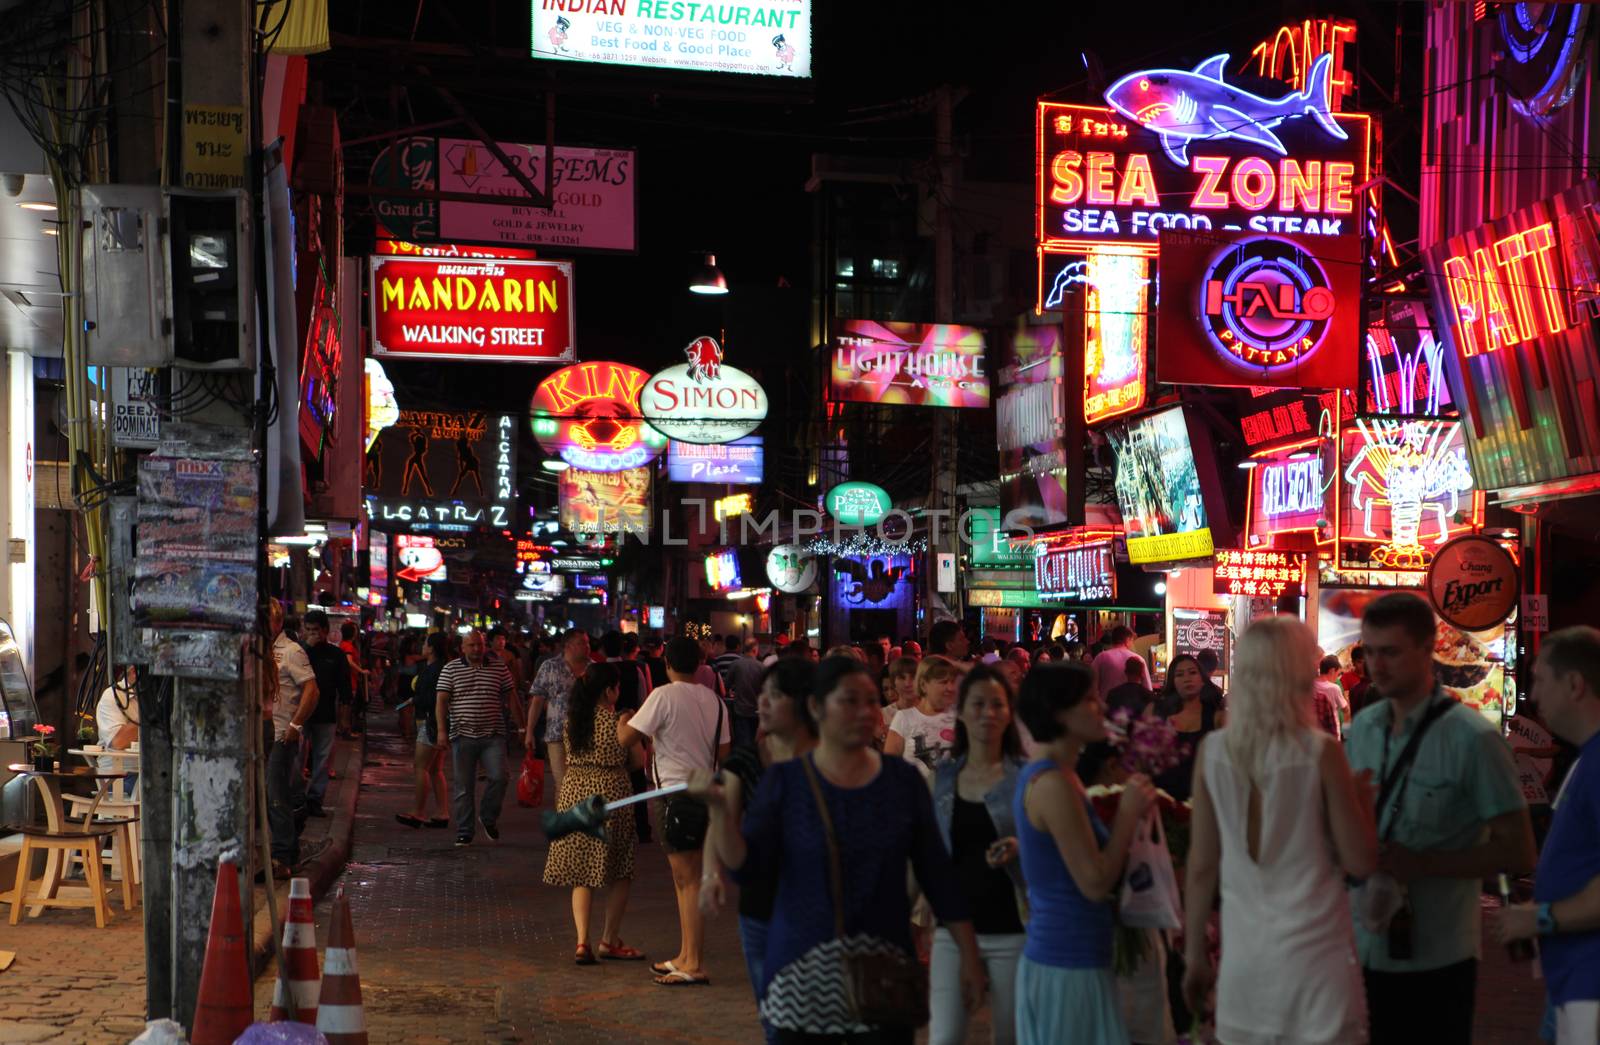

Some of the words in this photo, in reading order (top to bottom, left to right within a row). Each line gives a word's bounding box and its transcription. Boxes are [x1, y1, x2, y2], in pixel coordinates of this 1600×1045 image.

[542, 0, 626, 16] INDIAN
[637, 0, 802, 29] RESTAURANT
[596, 21, 624, 35] VEG
[629, 23, 637, 35] &
[644, 24, 705, 40] NON-VEG
[710, 28, 747, 43] FOOD
[591, 35, 620, 50] Best
[624, 37, 658, 52] Food
[662, 40, 672, 53] &
[678, 40, 714, 55] Good
[718, 42, 752, 58] Place
[1253, 17, 1357, 113] ONE
[185, 110, 243, 134] พระเยซู
[196, 141, 232, 157] ชนะ
[552, 157, 629, 187] GEMS
[1050, 151, 1160, 207] SEA
[1190, 156, 1355, 214] ZONE
[378, 200, 424, 216] Grand
[512, 206, 531, 217] BUY
[558, 192, 603, 208] GOLD
[492, 218, 520, 230] GOLD
[524, 221, 532, 230] &
[535, 221, 585, 233] JEWELRY
[1063, 209, 1120, 234] SEA
[1132, 211, 1212, 235] FOOD
[1249, 215, 1342, 236] STEAK
[381, 276, 558, 313] MANDARIN
[1206, 280, 1336, 321] HALO
[402, 324, 486, 347] WALKING
[490, 327, 545, 346] STREET
[836, 336, 874, 347] THE
[1219, 329, 1314, 365] PATTAYA
[541, 364, 642, 413] KIN
[910, 378, 924, 388] A
[652, 379, 760, 412] SIMON
[691, 460, 741, 478] Plaza
[552, 559, 601, 569] SENSATIONS
[1460, 560, 1493, 573] Chang
[1229, 580, 1287, 596] 价格公平
[1442, 577, 1504, 610] Export
